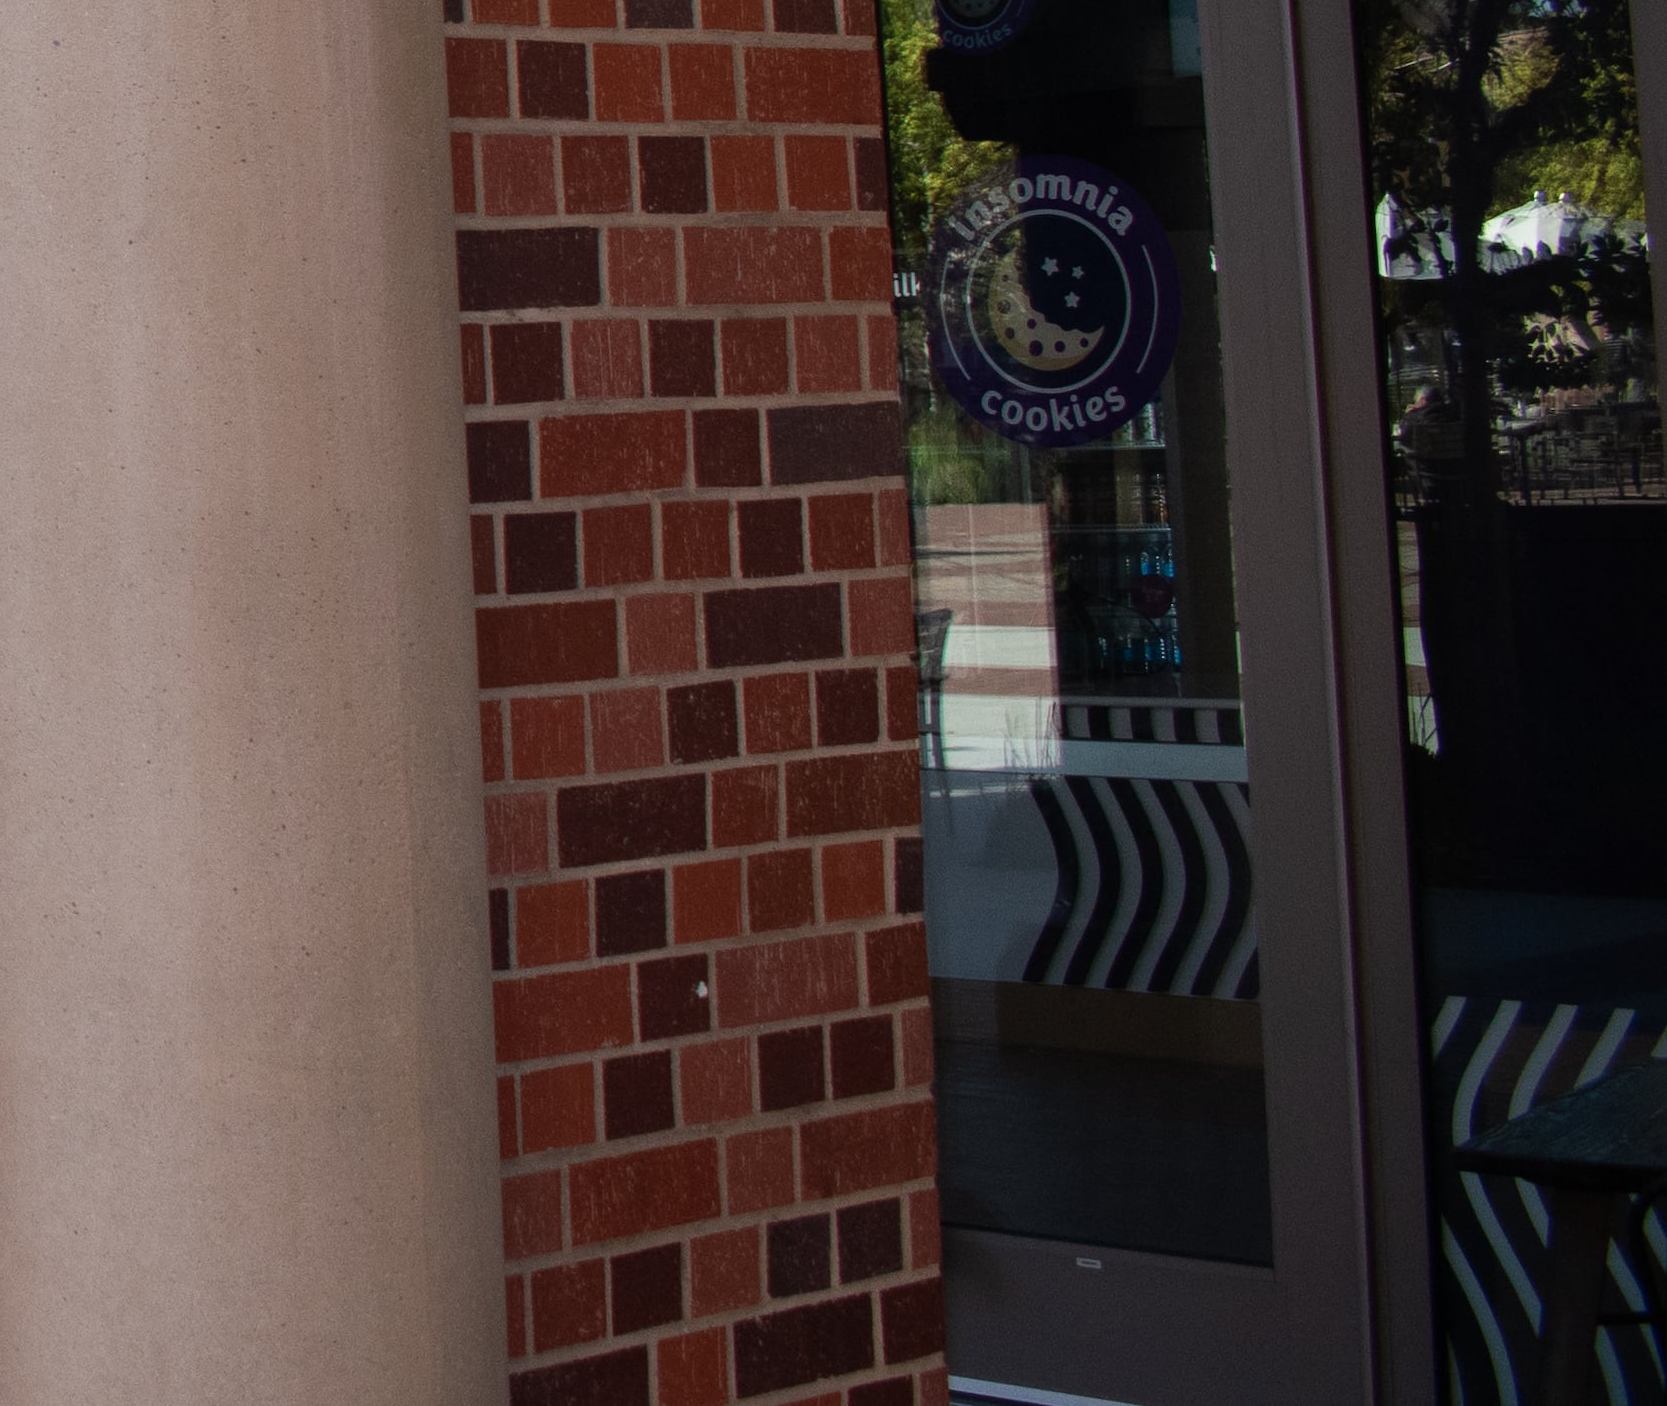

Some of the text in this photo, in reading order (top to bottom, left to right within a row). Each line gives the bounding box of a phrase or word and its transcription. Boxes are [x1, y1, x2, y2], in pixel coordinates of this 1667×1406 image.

[942, 22, 1012, 49] cookies
[947, 173, 1133, 242] insomnia
[980, 385, 1126, 432] cookies
